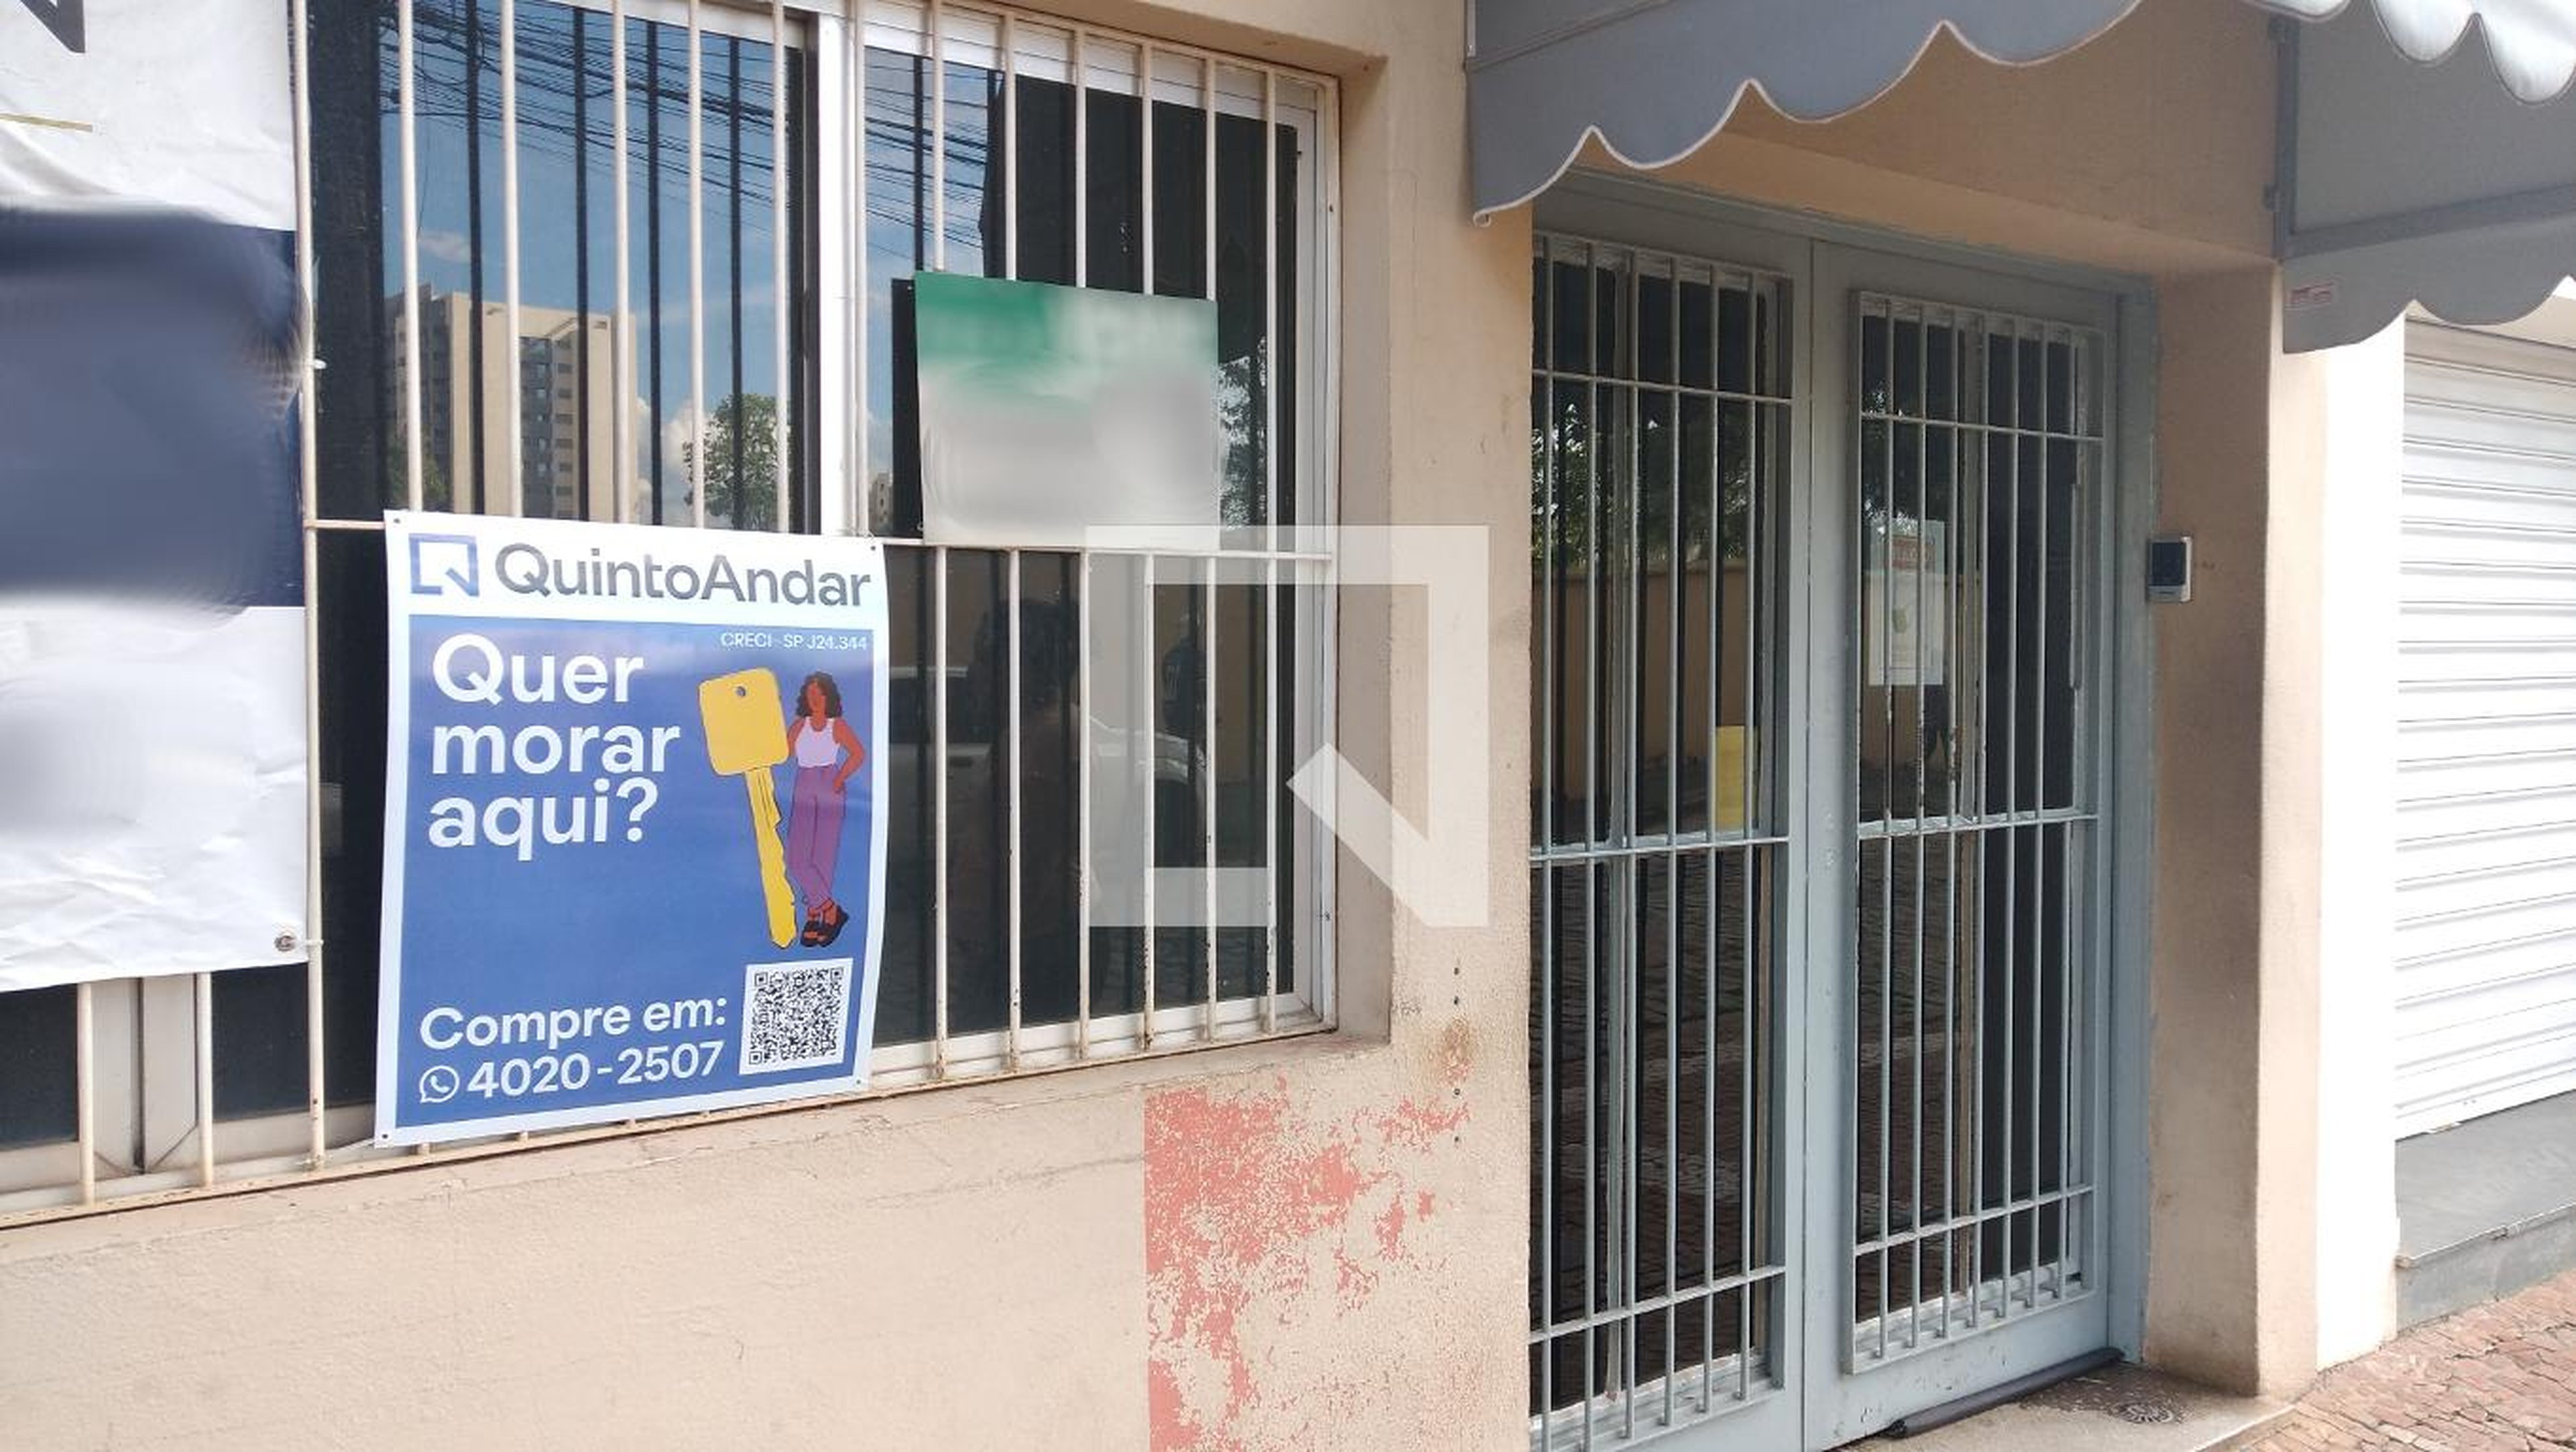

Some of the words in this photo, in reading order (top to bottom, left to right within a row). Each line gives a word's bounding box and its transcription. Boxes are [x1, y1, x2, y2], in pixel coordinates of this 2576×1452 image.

[495, 543, 871, 607] QuintoAndar
[720, 632, 772, 648] CRECI
[784, 634, 803, 648] SP
[433, 634, 643, 706] Quer
[433, 722, 680, 775] morar
[428, 776, 659, 861] aqui?
[420, 1005, 631, 1050] Compre
[643, 997, 727, 1031] em:
